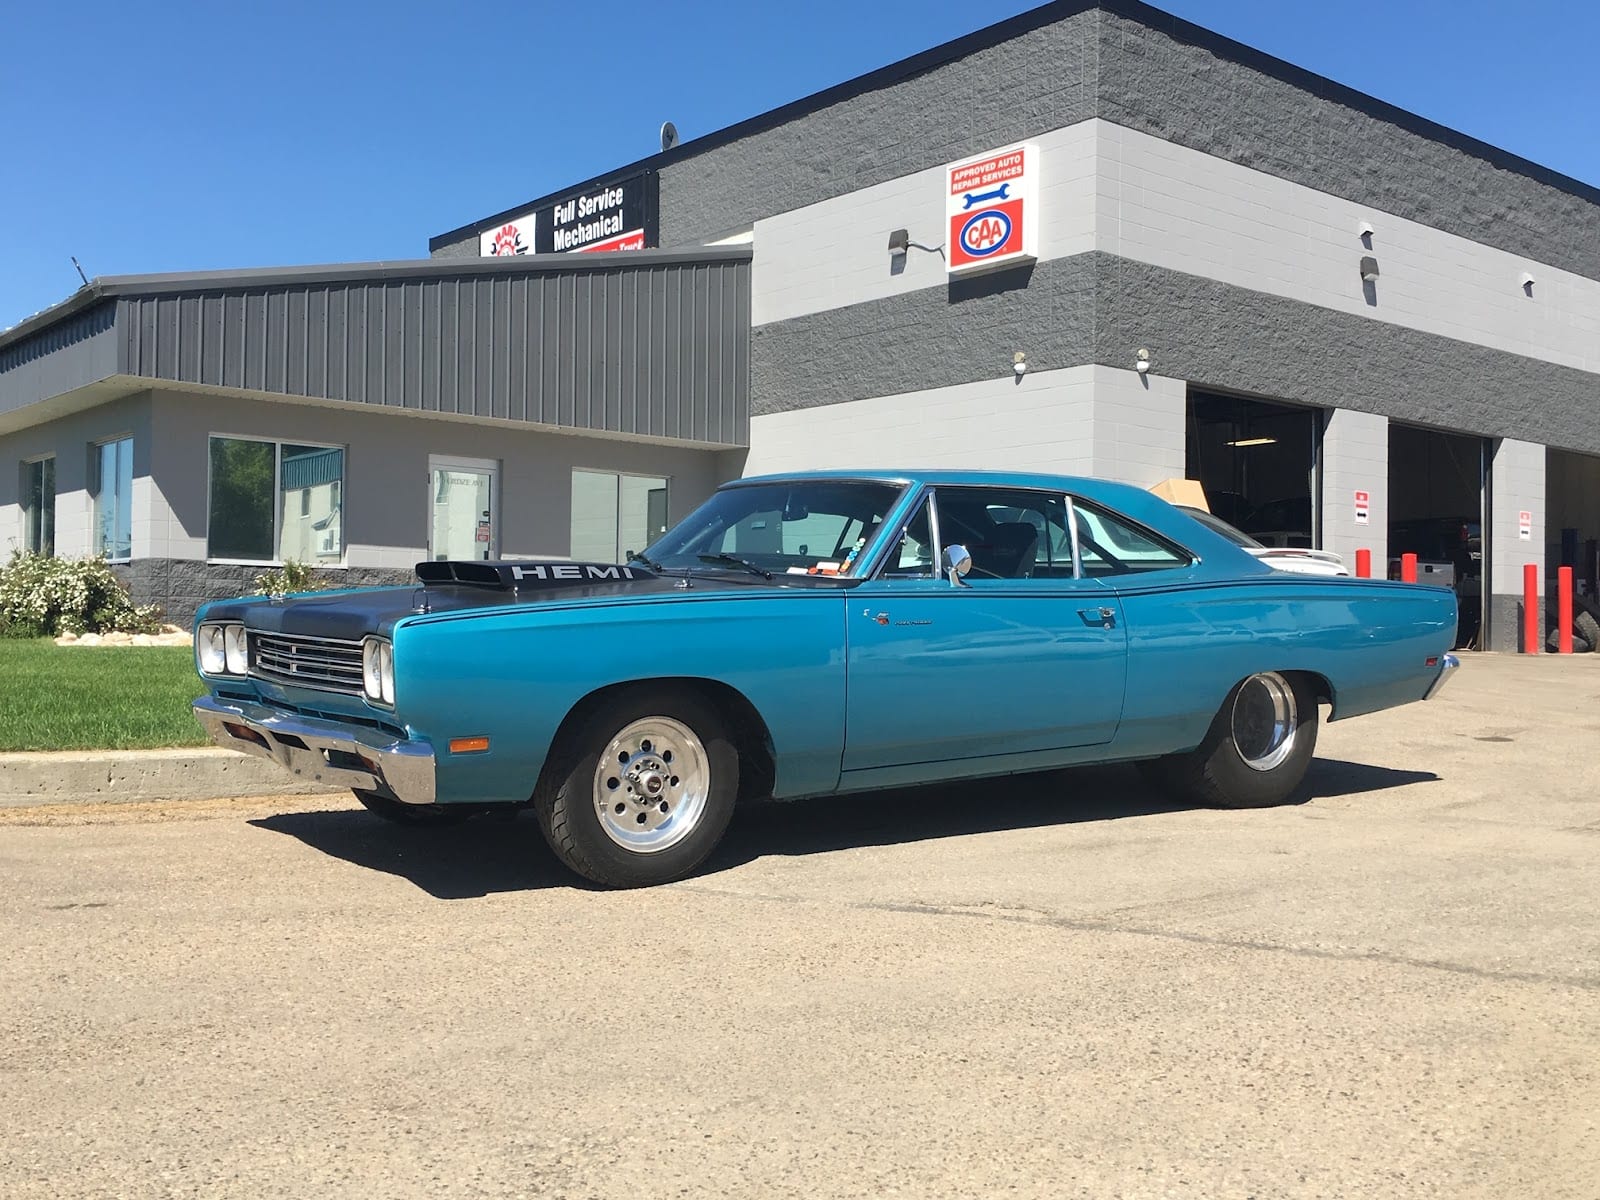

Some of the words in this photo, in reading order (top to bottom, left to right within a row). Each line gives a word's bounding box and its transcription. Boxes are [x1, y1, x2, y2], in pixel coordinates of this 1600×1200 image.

[952, 177, 981, 192] REPAIR
[982, 165, 1022, 183] SERVICES
[954, 161, 996, 180] APPROVED
[998, 154, 1021, 166] AUTO
[553, 200, 575, 226] Full
[578, 187, 624, 218] Service
[553, 209, 624, 252] Mechanical
[968, 218, 1002, 248] CAA
[511, 565, 634, 580] HEMI
